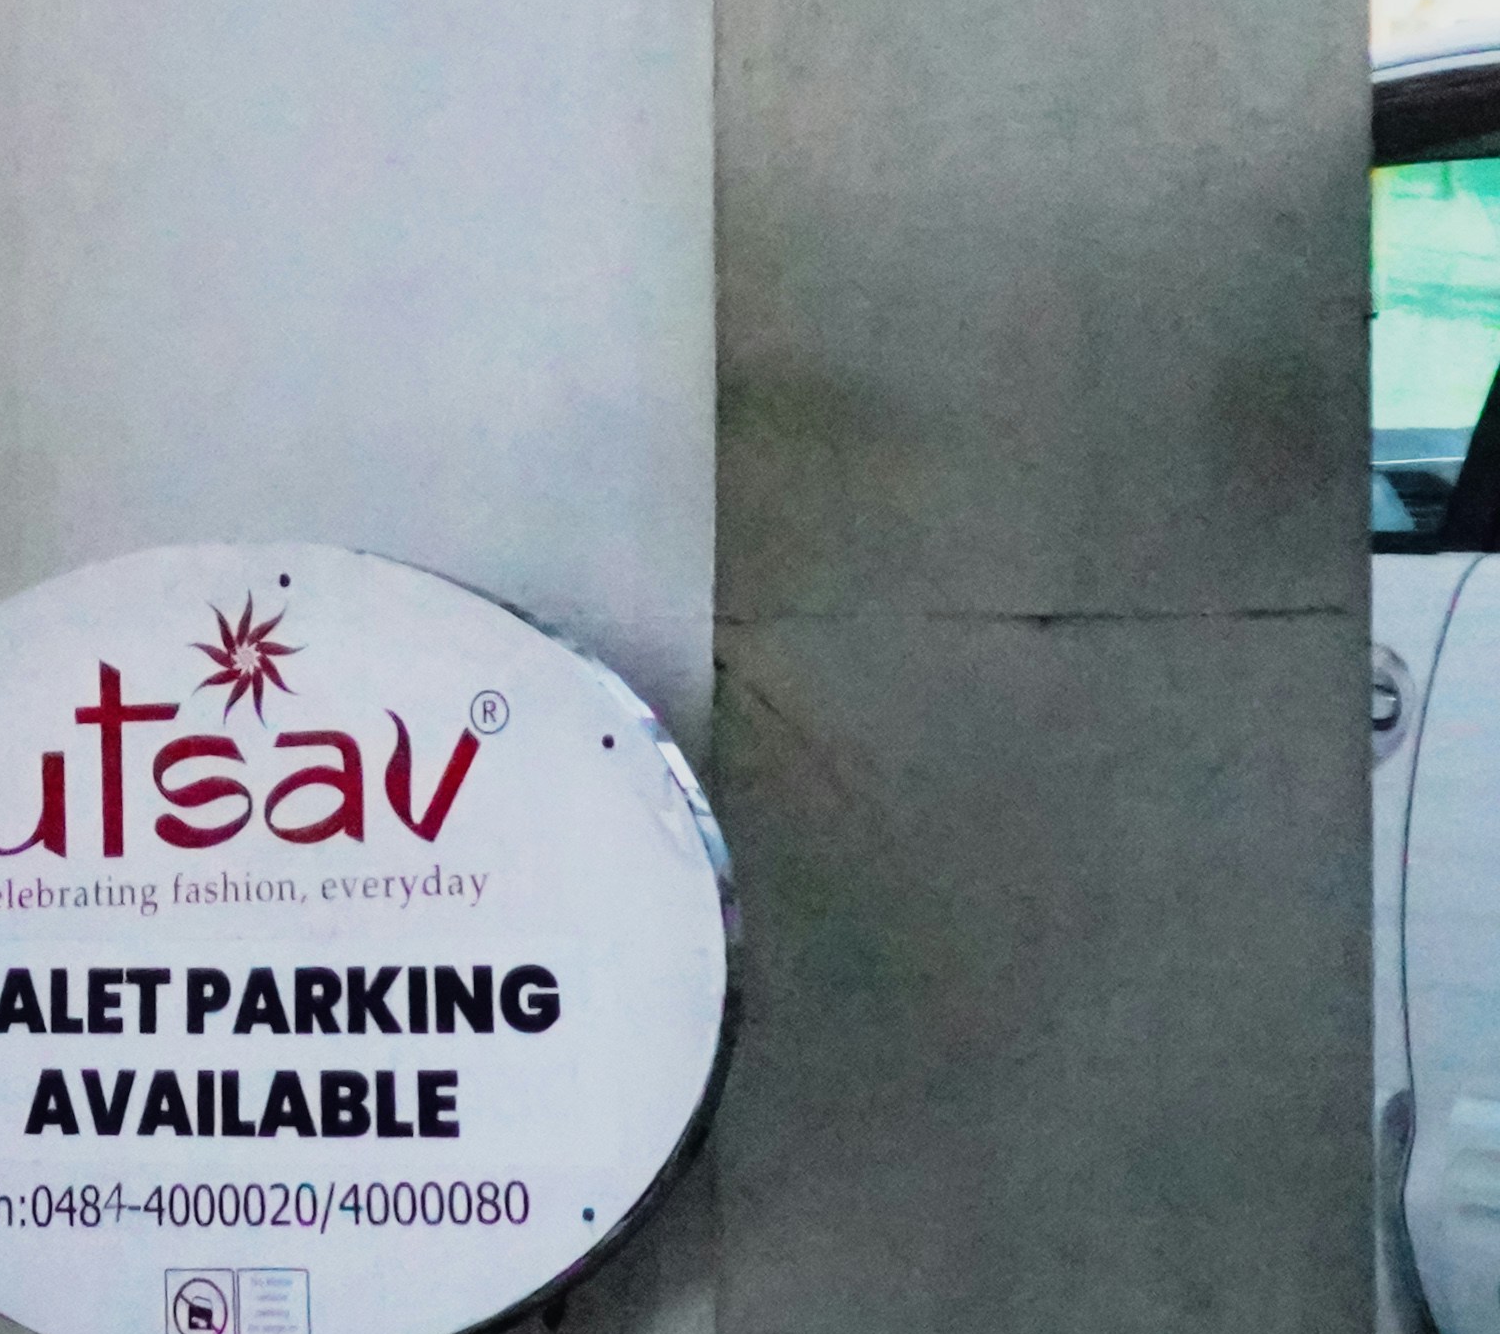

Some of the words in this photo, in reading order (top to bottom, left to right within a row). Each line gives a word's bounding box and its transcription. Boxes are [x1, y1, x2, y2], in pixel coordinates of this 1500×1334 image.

[173, 872, 308, 905] fashion,
[320, 865, 489, 908] everyday
[186, 964, 562, 1035] PARKING
[24, 1068, 461, 1139] AVAILABLE
